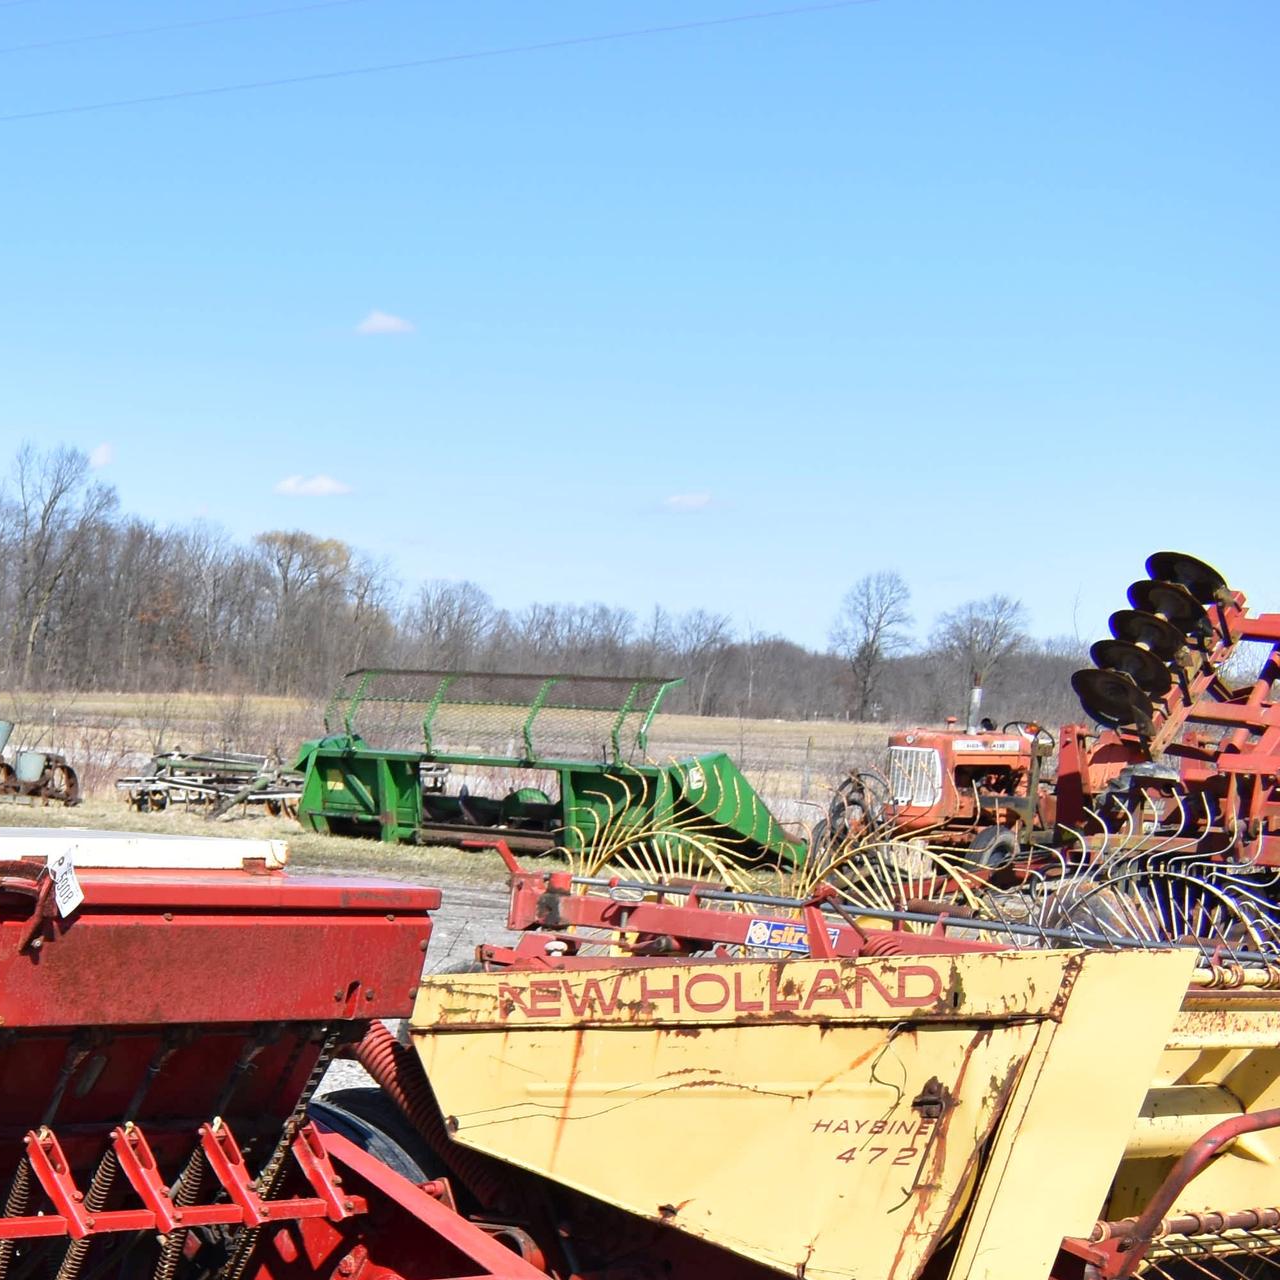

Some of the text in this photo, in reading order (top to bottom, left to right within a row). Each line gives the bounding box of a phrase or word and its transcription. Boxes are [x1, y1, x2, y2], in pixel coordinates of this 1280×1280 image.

[498, 965, 942, 1019] NEW HOLLAND
[811, 1118, 933, 1136] HAYBINE
[836, 1147, 917, 1167] 472
